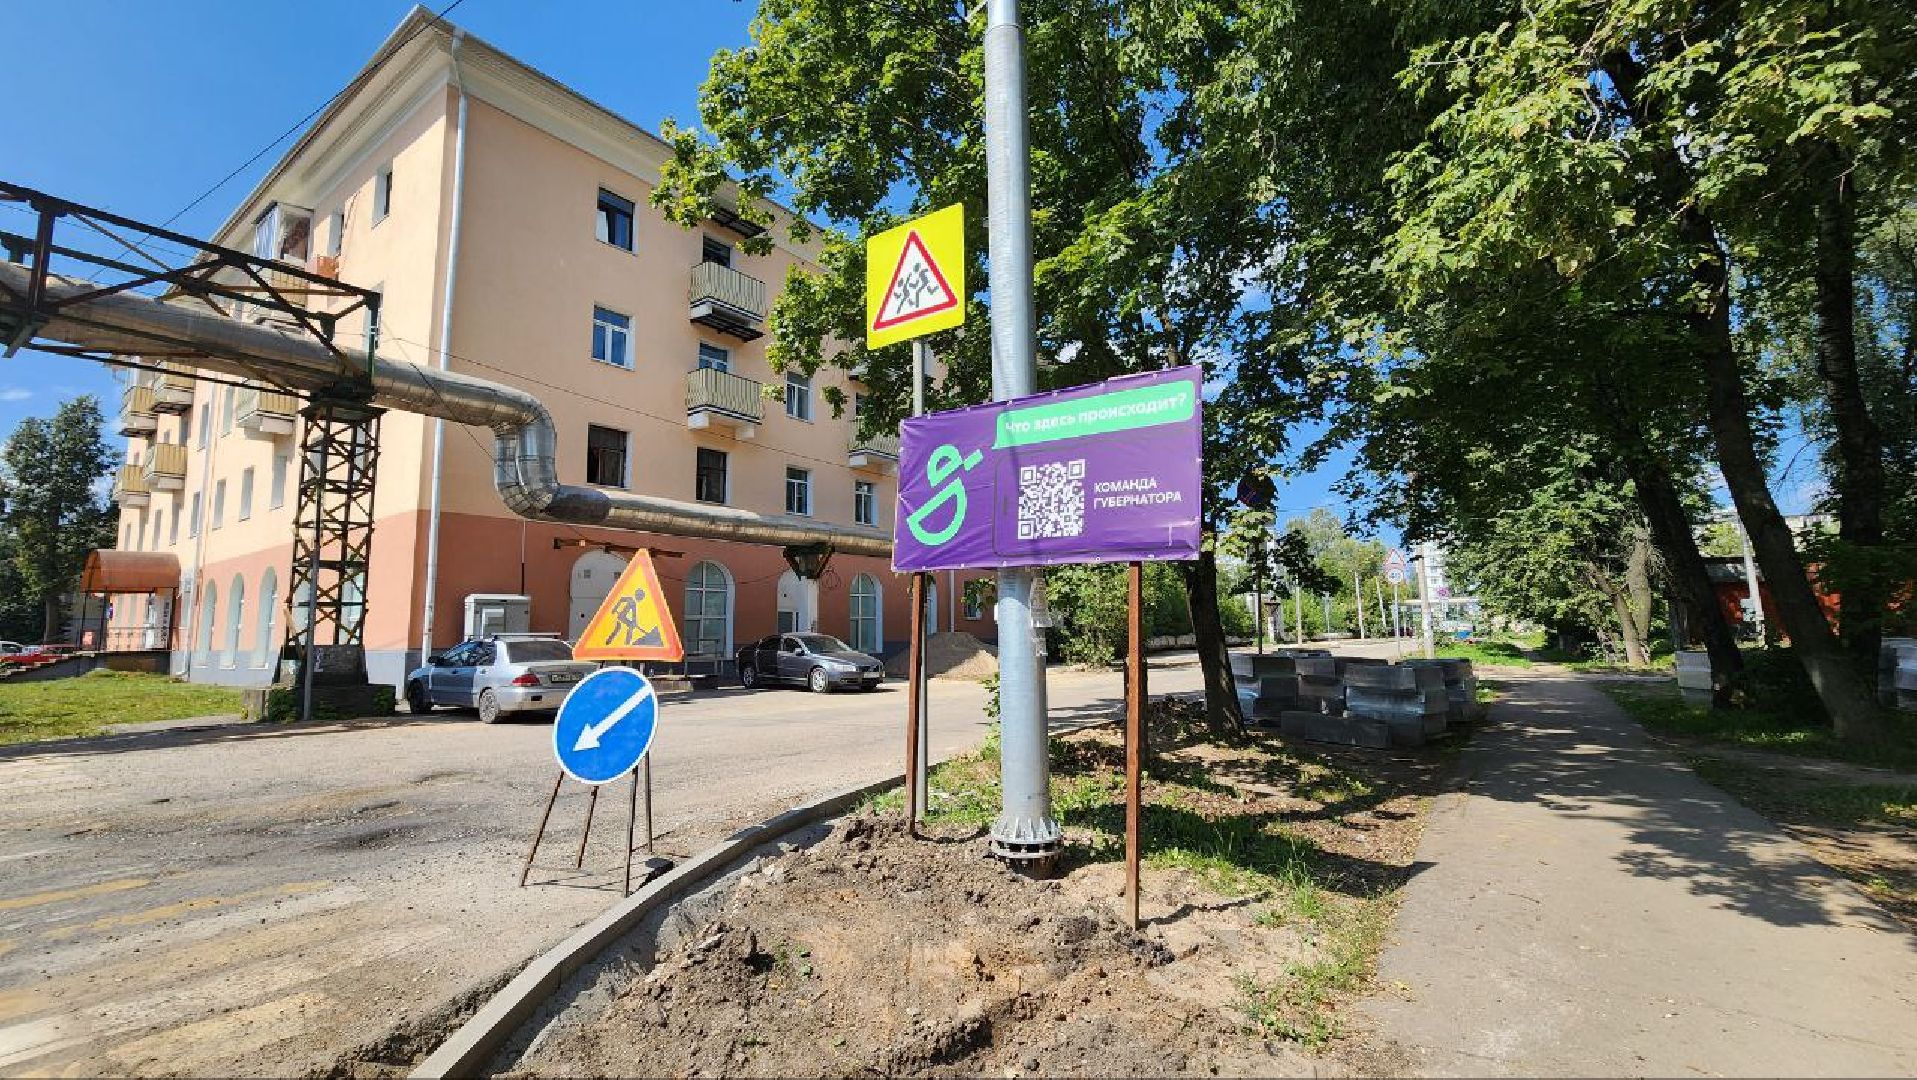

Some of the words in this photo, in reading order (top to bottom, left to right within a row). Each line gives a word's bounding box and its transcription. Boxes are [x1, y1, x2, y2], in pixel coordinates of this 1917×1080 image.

[1006, 420, 1031, 434] Что
[1034, 416, 1077, 432] здесь
[1079, 392, 1188, 425] происходит?
[1094, 476, 1157, 493] КОМАНДА
[1094, 491, 1182, 510] ГУБЕРНАТОРА
